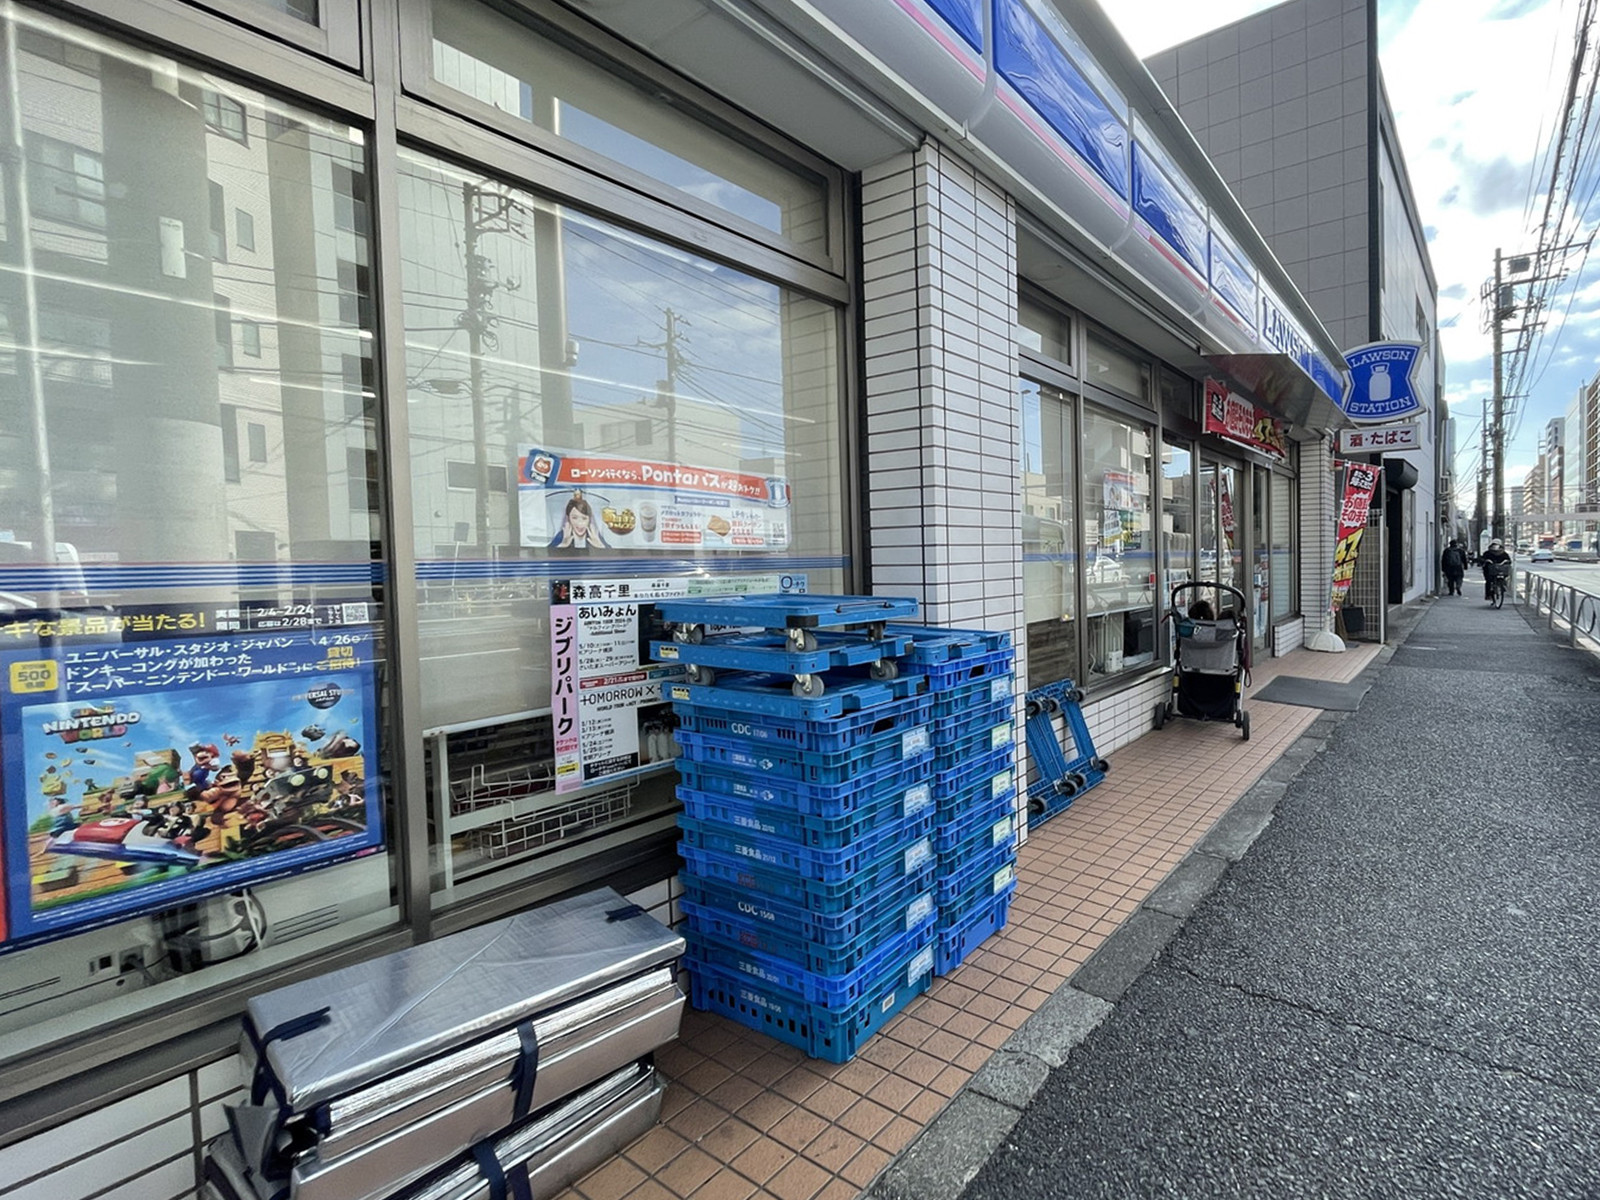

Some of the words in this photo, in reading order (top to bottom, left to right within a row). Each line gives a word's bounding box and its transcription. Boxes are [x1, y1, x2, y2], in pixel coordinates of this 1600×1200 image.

[1351, 350, 1411, 367] LAWSON
[1349, 397, 1412, 413] STATION
[572, 584, 631, 600] 森高千里
[578, 604, 637, 620] あいみょん
[66, 652, 252, 681] ドンキーコングが加わった
[18, 669, 52, 682] 500
[555, 616, 574, 738] ジブリパーク
[42, 711, 142, 734] NINTENDO
[731, 722, 752, 736] CDC
[738, 901, 759, 916] CDC
